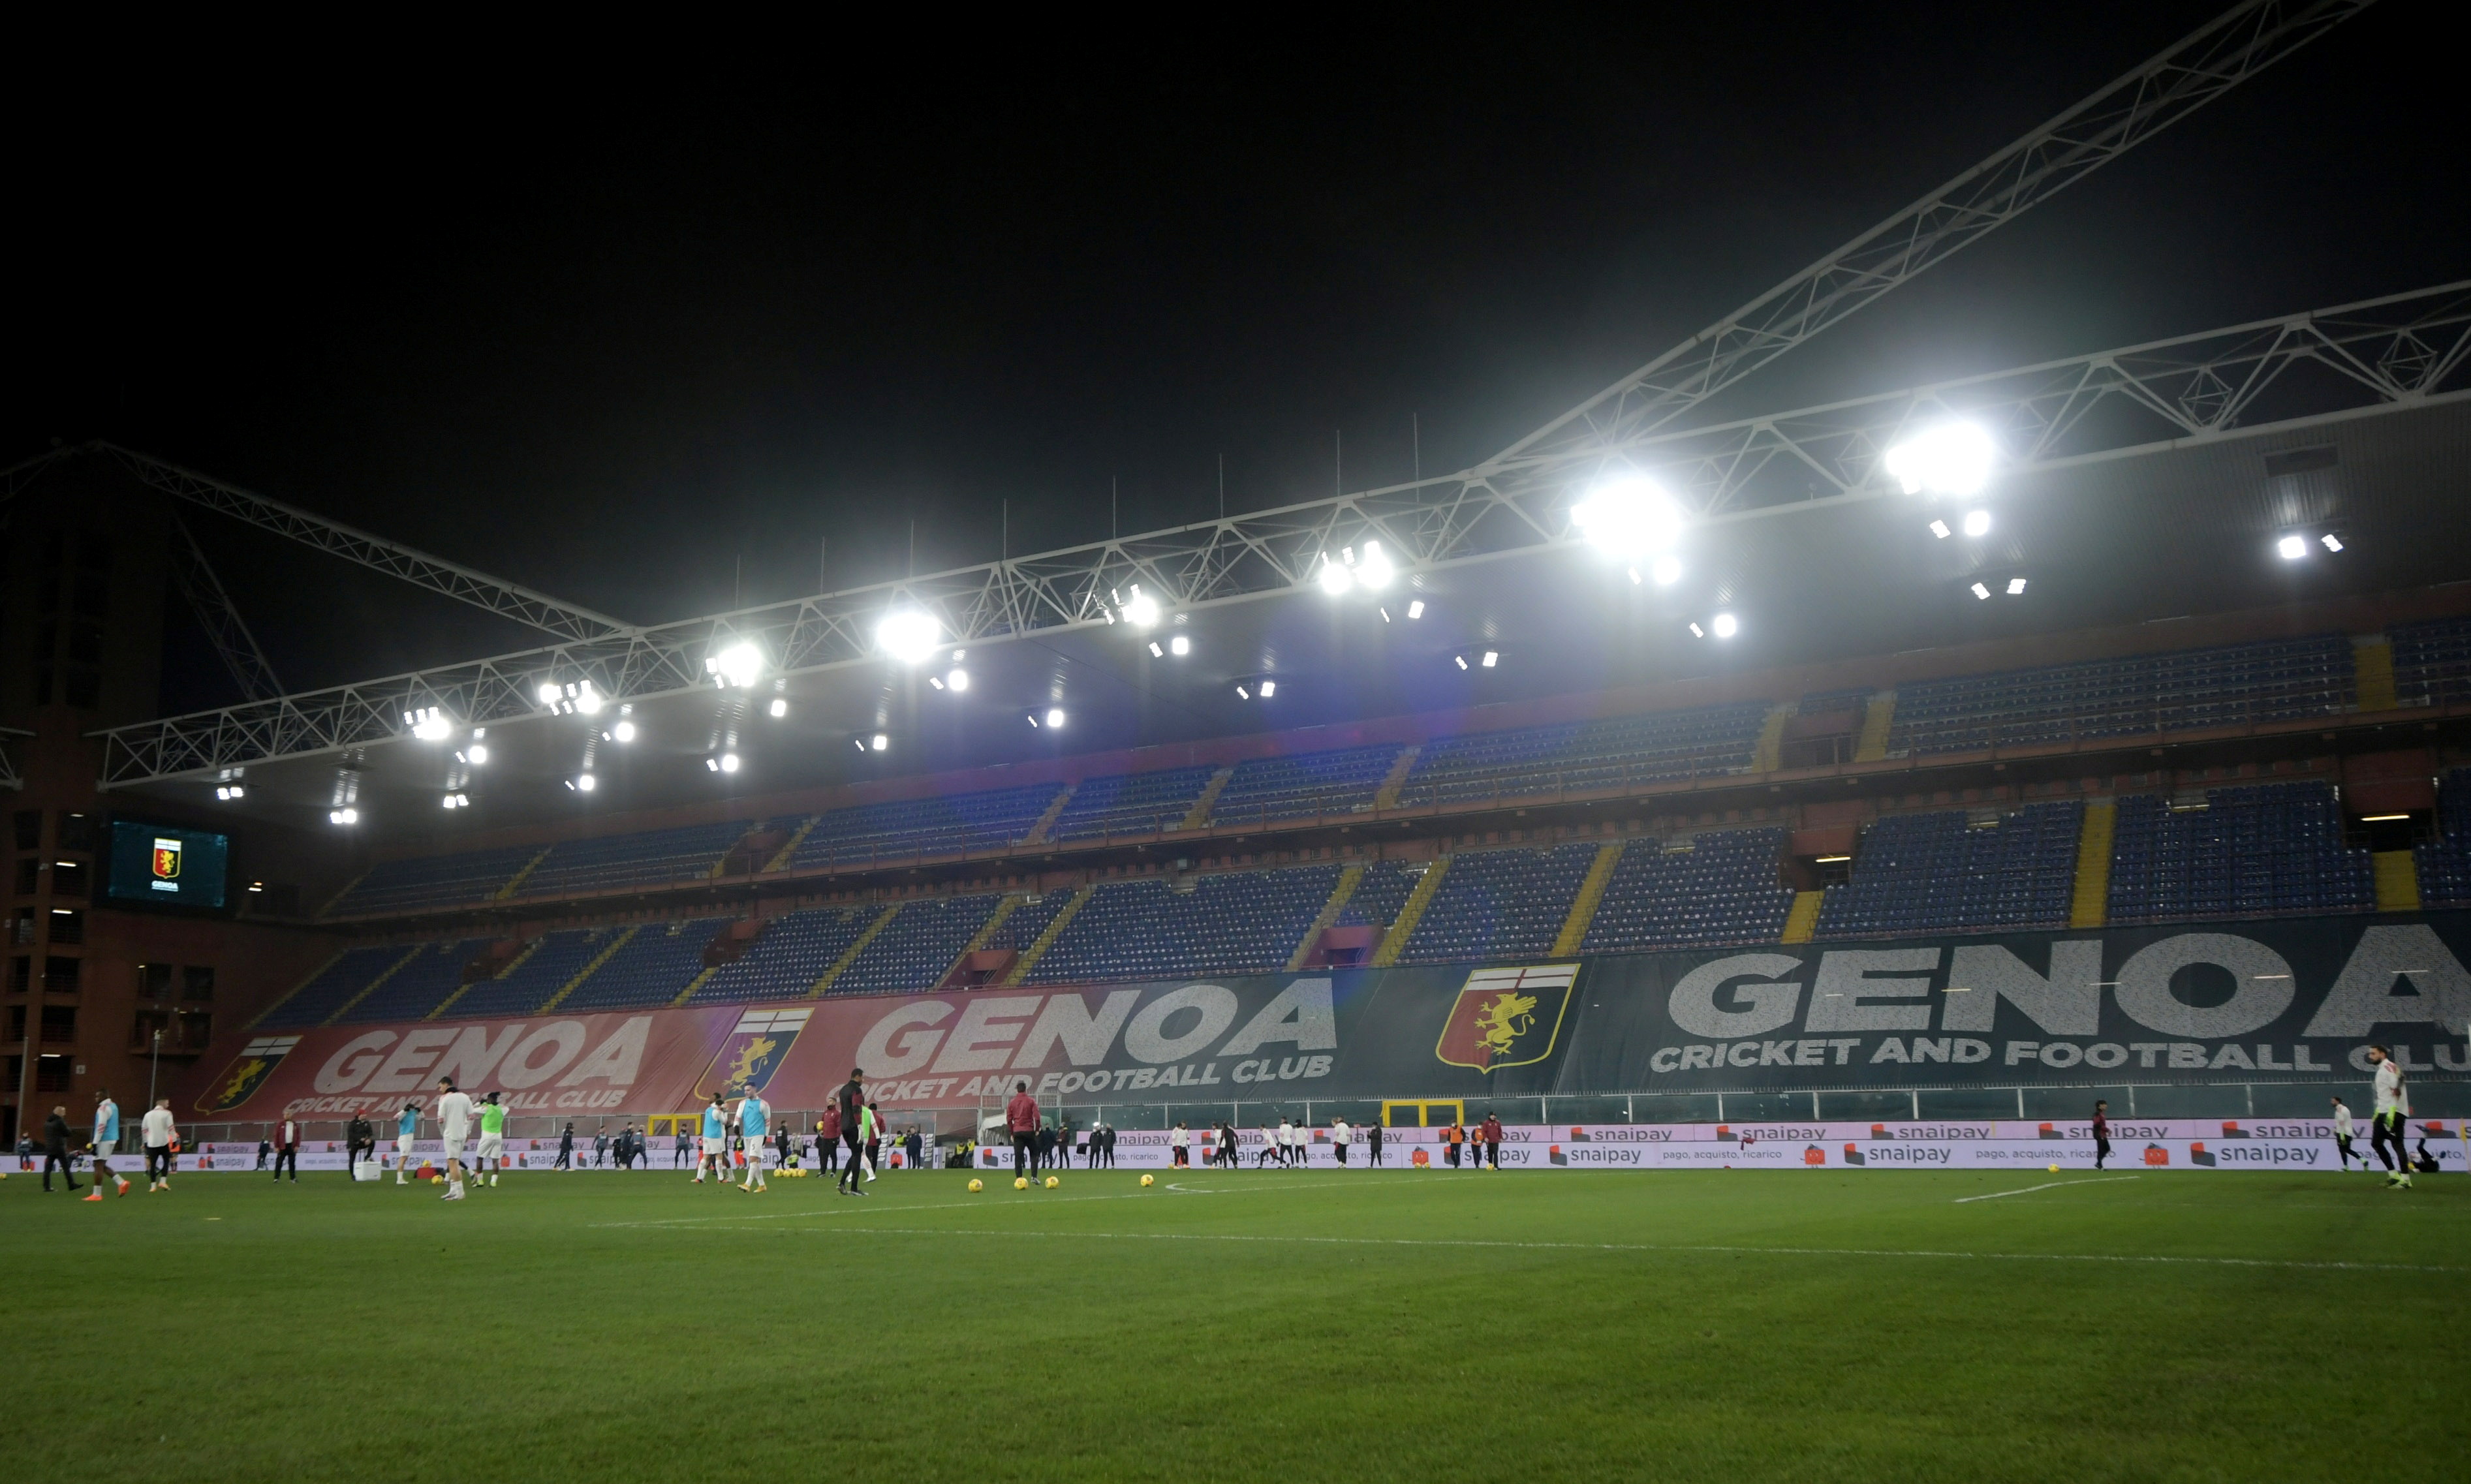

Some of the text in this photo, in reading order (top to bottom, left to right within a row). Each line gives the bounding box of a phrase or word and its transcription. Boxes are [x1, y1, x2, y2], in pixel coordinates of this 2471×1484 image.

[151, 880, 178, 889] GENOA
[1669, 923, 2471, 1038] GENOA
[856, 978, 1337, 1079] GENOA
[314, 1016, 653, 1094] GENOA
[1650, 1039, 1860, 1073] CRICKET
[1869, 1038, 1991, 1066] AND
[2004, 1041, 2332, 1072] FOOTBALL
[826, 1055, 1333, 1103] CICKET AND FOOTBALL CLUB
[283, 1090, 627, 1113] CRICKET AND FBALL CLUB
[1115, 1134, 1170, 1145] naipay
[1595, 1128, 1672, 1142] snaipay
[1742, 1126, 1826, 1140] snaipay
[1899, 1124, 1989, 1139] snaipay
[2069, 1124, 2168, 1139] snipay
[2256, 1122, 2365, 1139] snaipy
[1571, 1145, 1641, 1164] snaipay
[1694, 1150, 1739, 1160] acquisto,
[1743, 1150, 1782, 1158] ricarico
[1869, 1143, 1951, 1164] snaipay
[1976, 1150, 2009, 1159] pago,
[2012, 1149, 2066, 1159] acquisto,
[2221, 1143, 2318, 1164] snaipay
